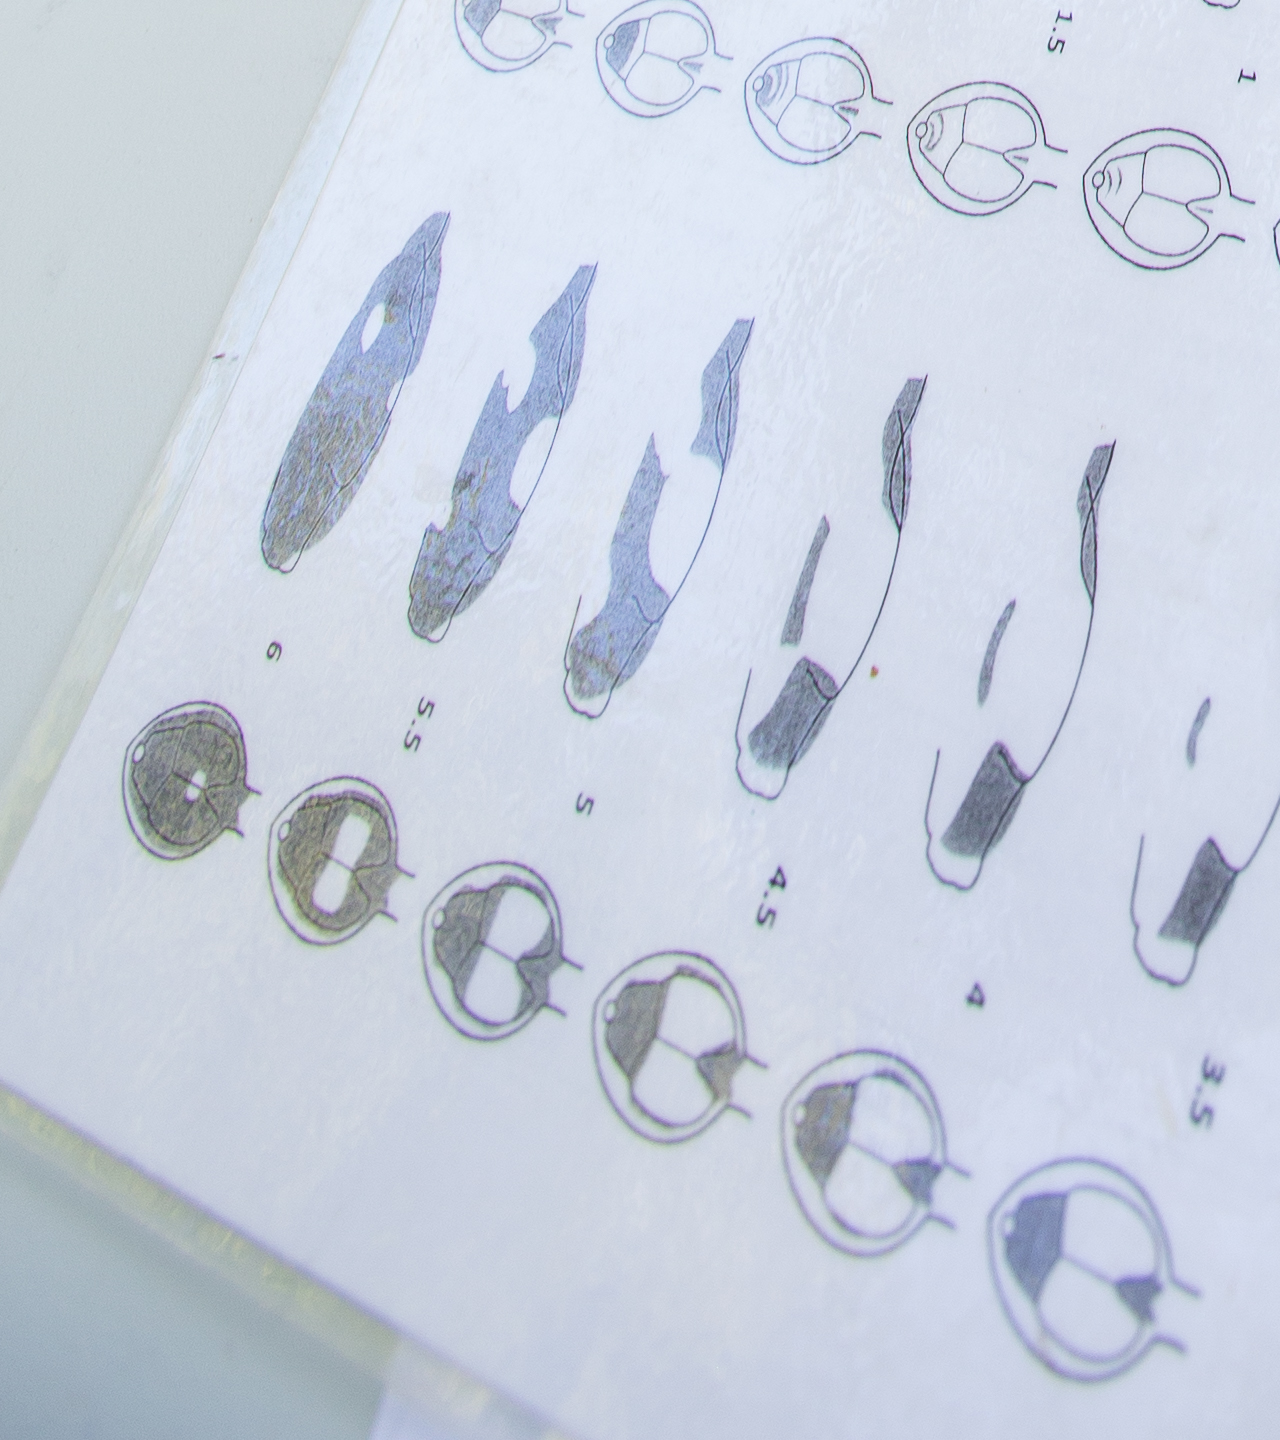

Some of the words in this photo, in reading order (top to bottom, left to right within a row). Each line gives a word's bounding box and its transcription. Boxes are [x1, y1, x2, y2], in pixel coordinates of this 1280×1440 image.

[1046, 10, 1073, 54] 1.5
[1237, 68, 1257, 84] 1
[403, 696, 436, 752] 5.5
[575, 792, 595, 816] 5
[755, 865, 788, 927] 4.5
[965, 982, 986, 1009] 4
[1189, 1055, 1226, 1127] 3.5
